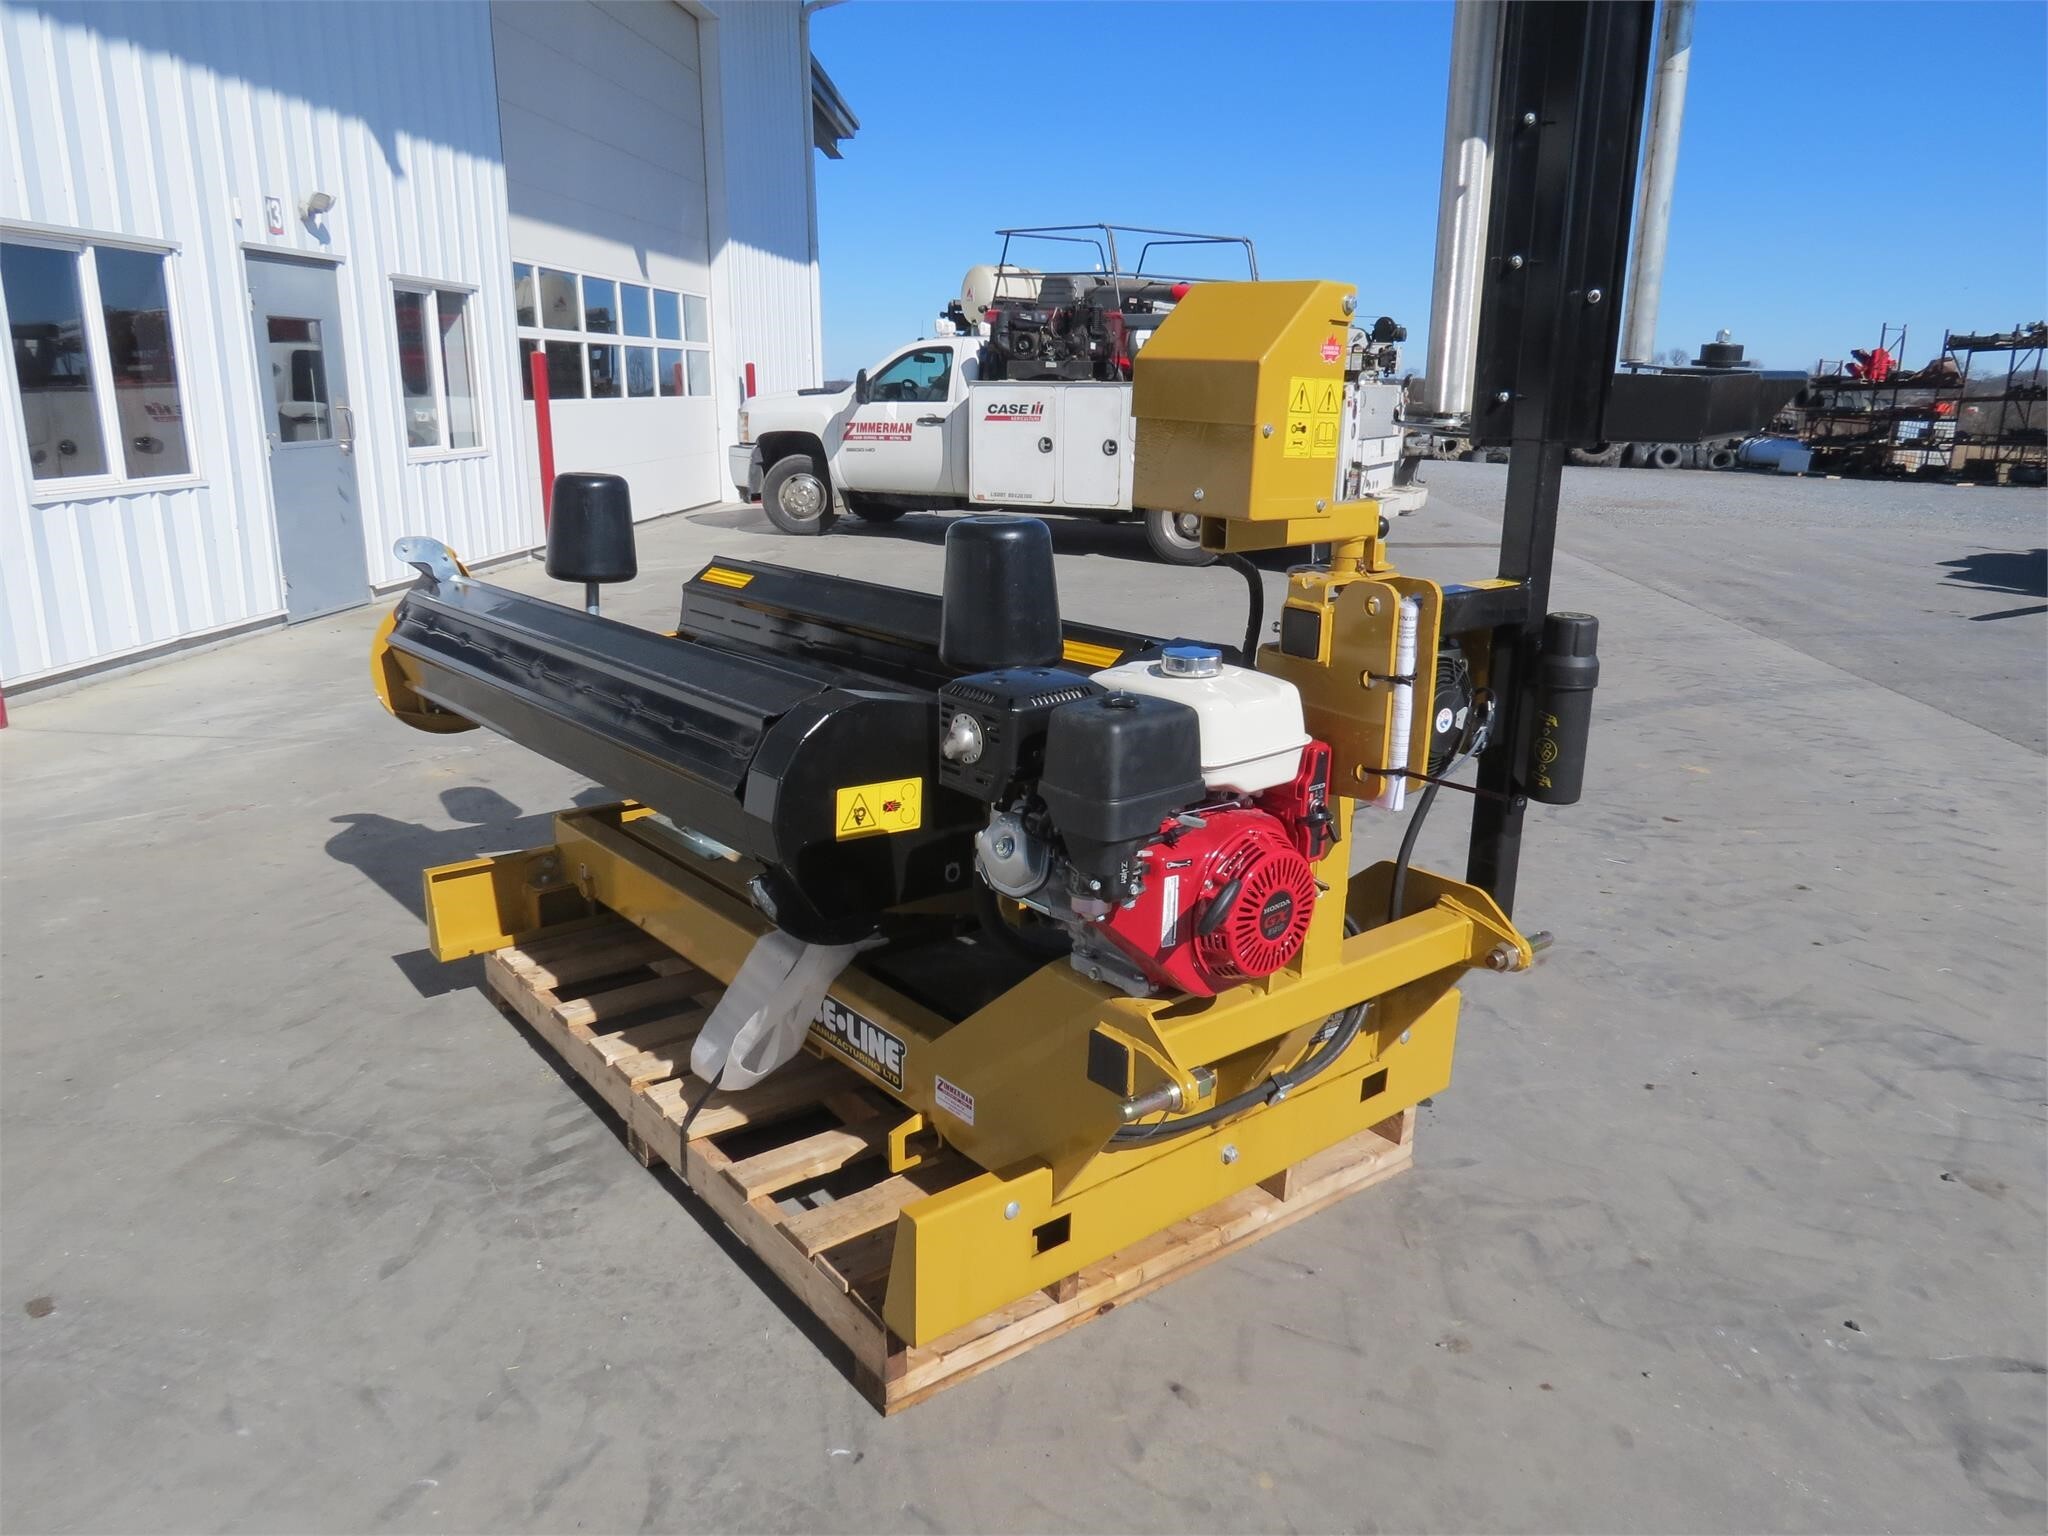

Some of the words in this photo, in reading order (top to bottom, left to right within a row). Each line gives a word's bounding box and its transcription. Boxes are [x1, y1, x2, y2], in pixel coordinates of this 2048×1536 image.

[987, 403, 1029, 414] CASE
[843, 422, 912, 440] ZIMMERMAN
[1263, 899, 1291, 915] HONDA
[882, 1068, 900, 1085] LTD
[937, 1078, 973, 1106] ZIMMERMAN
